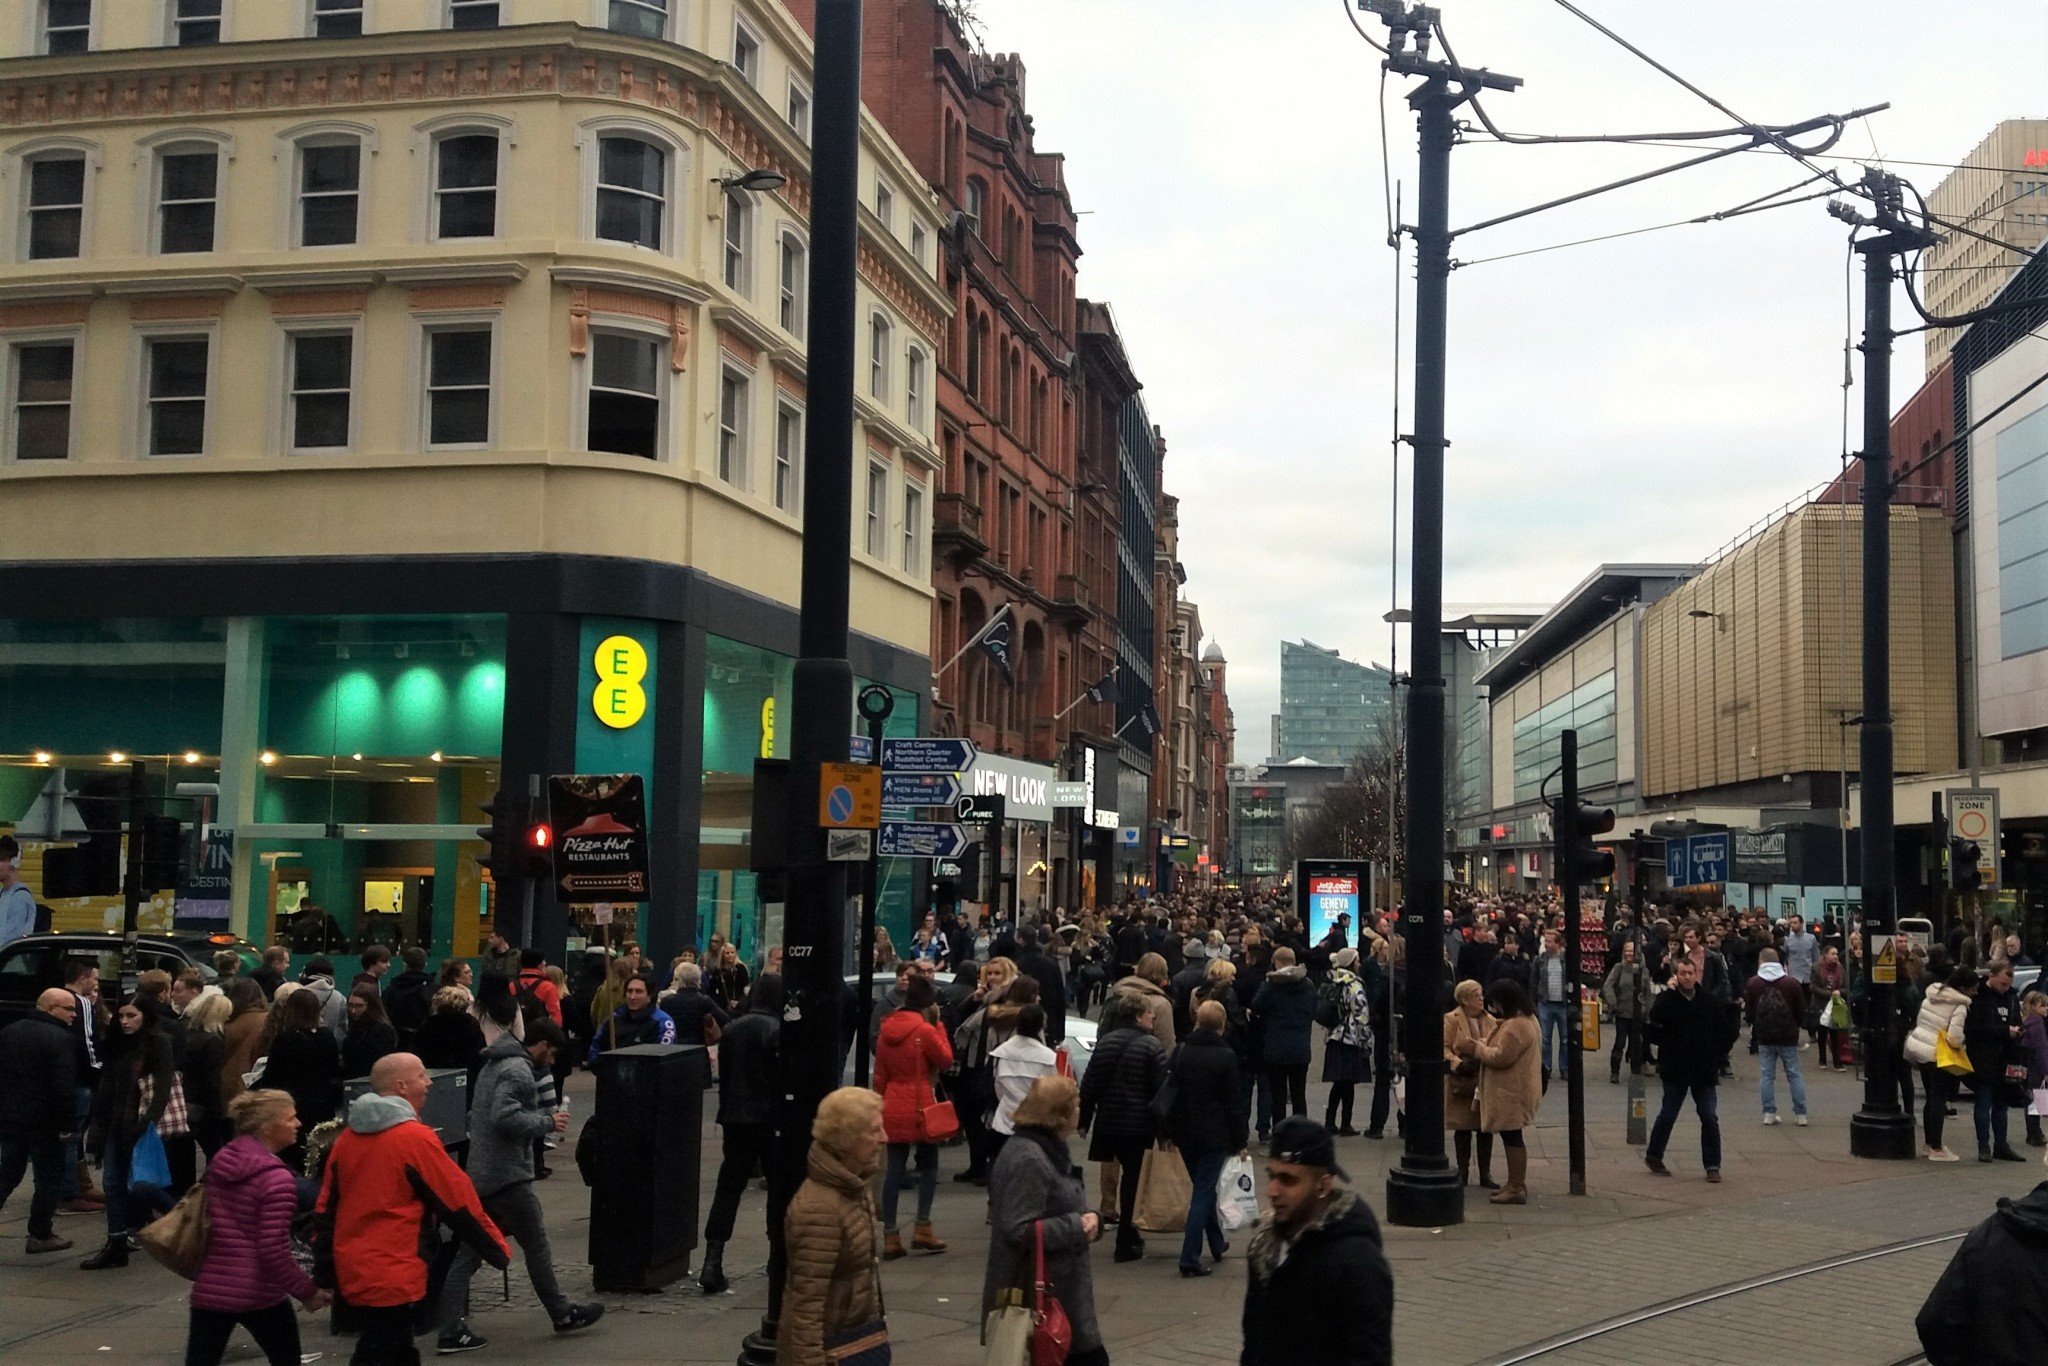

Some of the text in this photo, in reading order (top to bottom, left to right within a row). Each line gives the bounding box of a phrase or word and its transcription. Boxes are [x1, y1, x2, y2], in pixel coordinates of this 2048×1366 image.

[895, 741, 936, 749] Craft Centre
[974, 769, 1046, 806] NEW LOOK
[563, 837, 634, 852] Pizza Hut
[568, 852, 630, 861] RESTAURANTS
[1316, 882, 1352, 890] Jet2.com
[1320, 897, 1349, 910] GENEVA
[1324, 909, 1344, 920] £2
[789, 946, 813, 957] CC77
